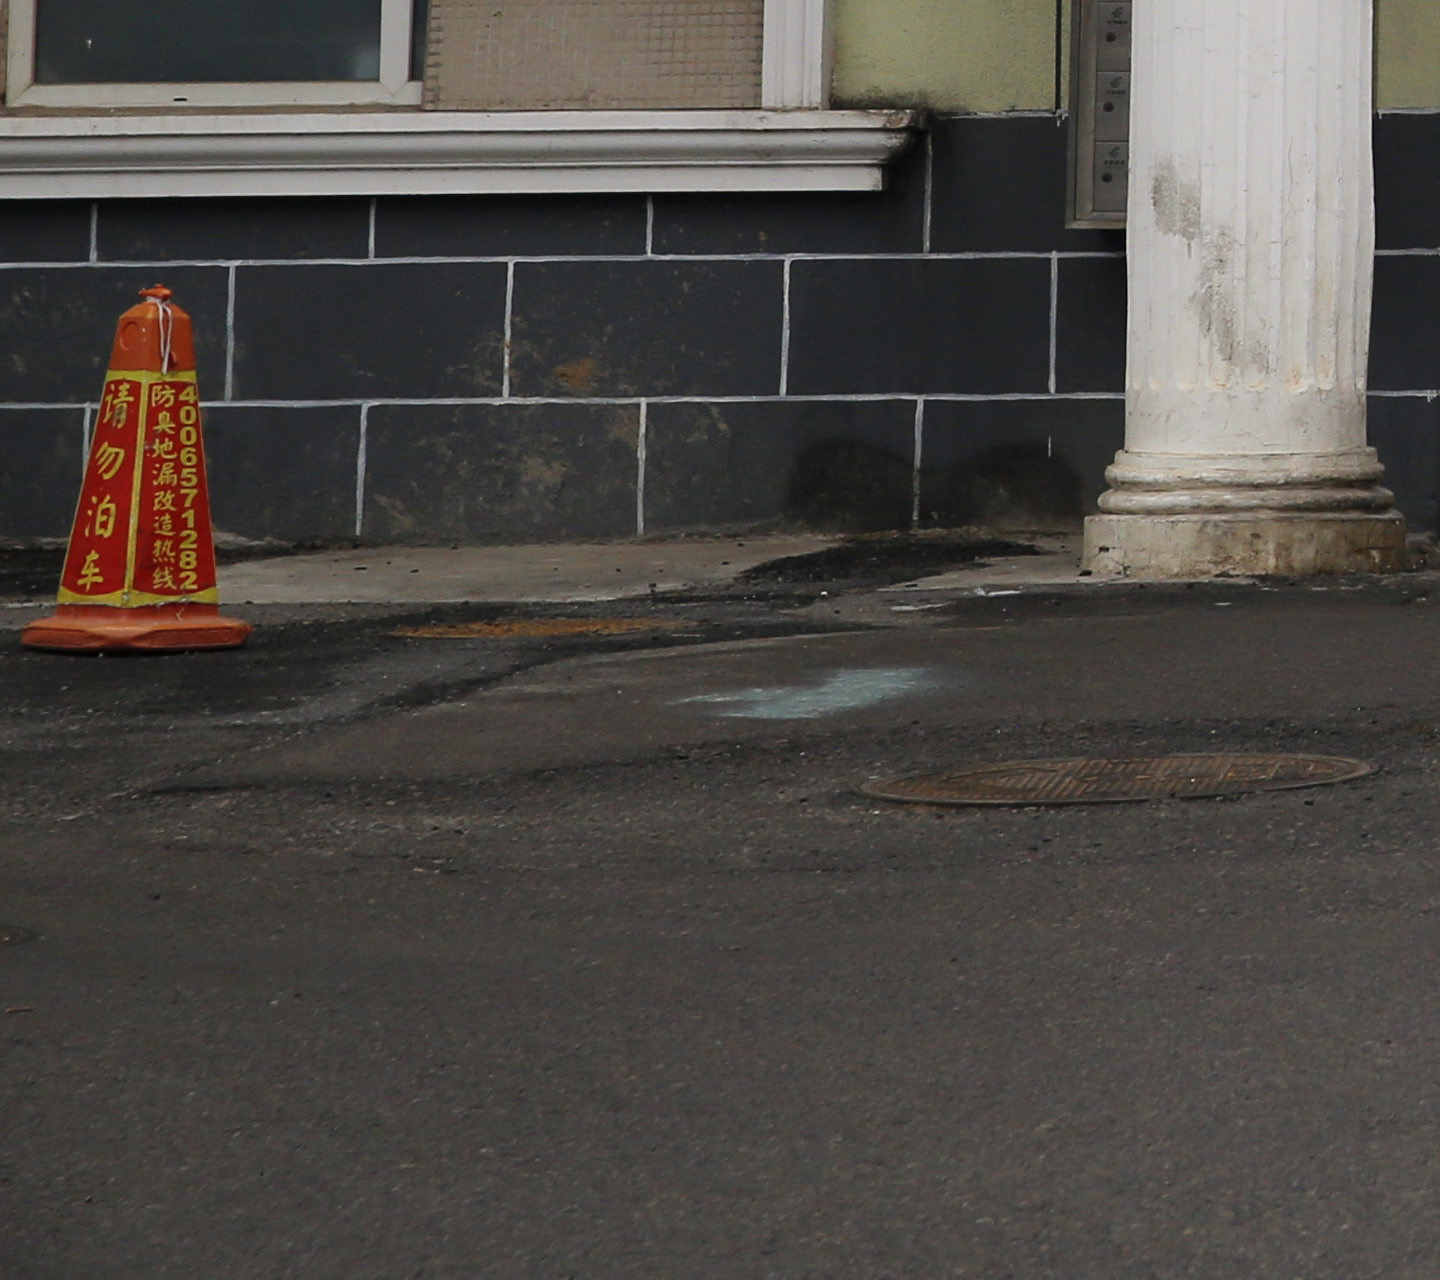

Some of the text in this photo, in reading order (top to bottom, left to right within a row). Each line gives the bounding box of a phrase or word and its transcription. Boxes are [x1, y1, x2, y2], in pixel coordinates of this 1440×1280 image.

[77, 382, 135, 592] 请勿泊车
[151, 384, 178, 591] 防臭地漏改造热线
[178, 385, 199, 592] 4006571282
